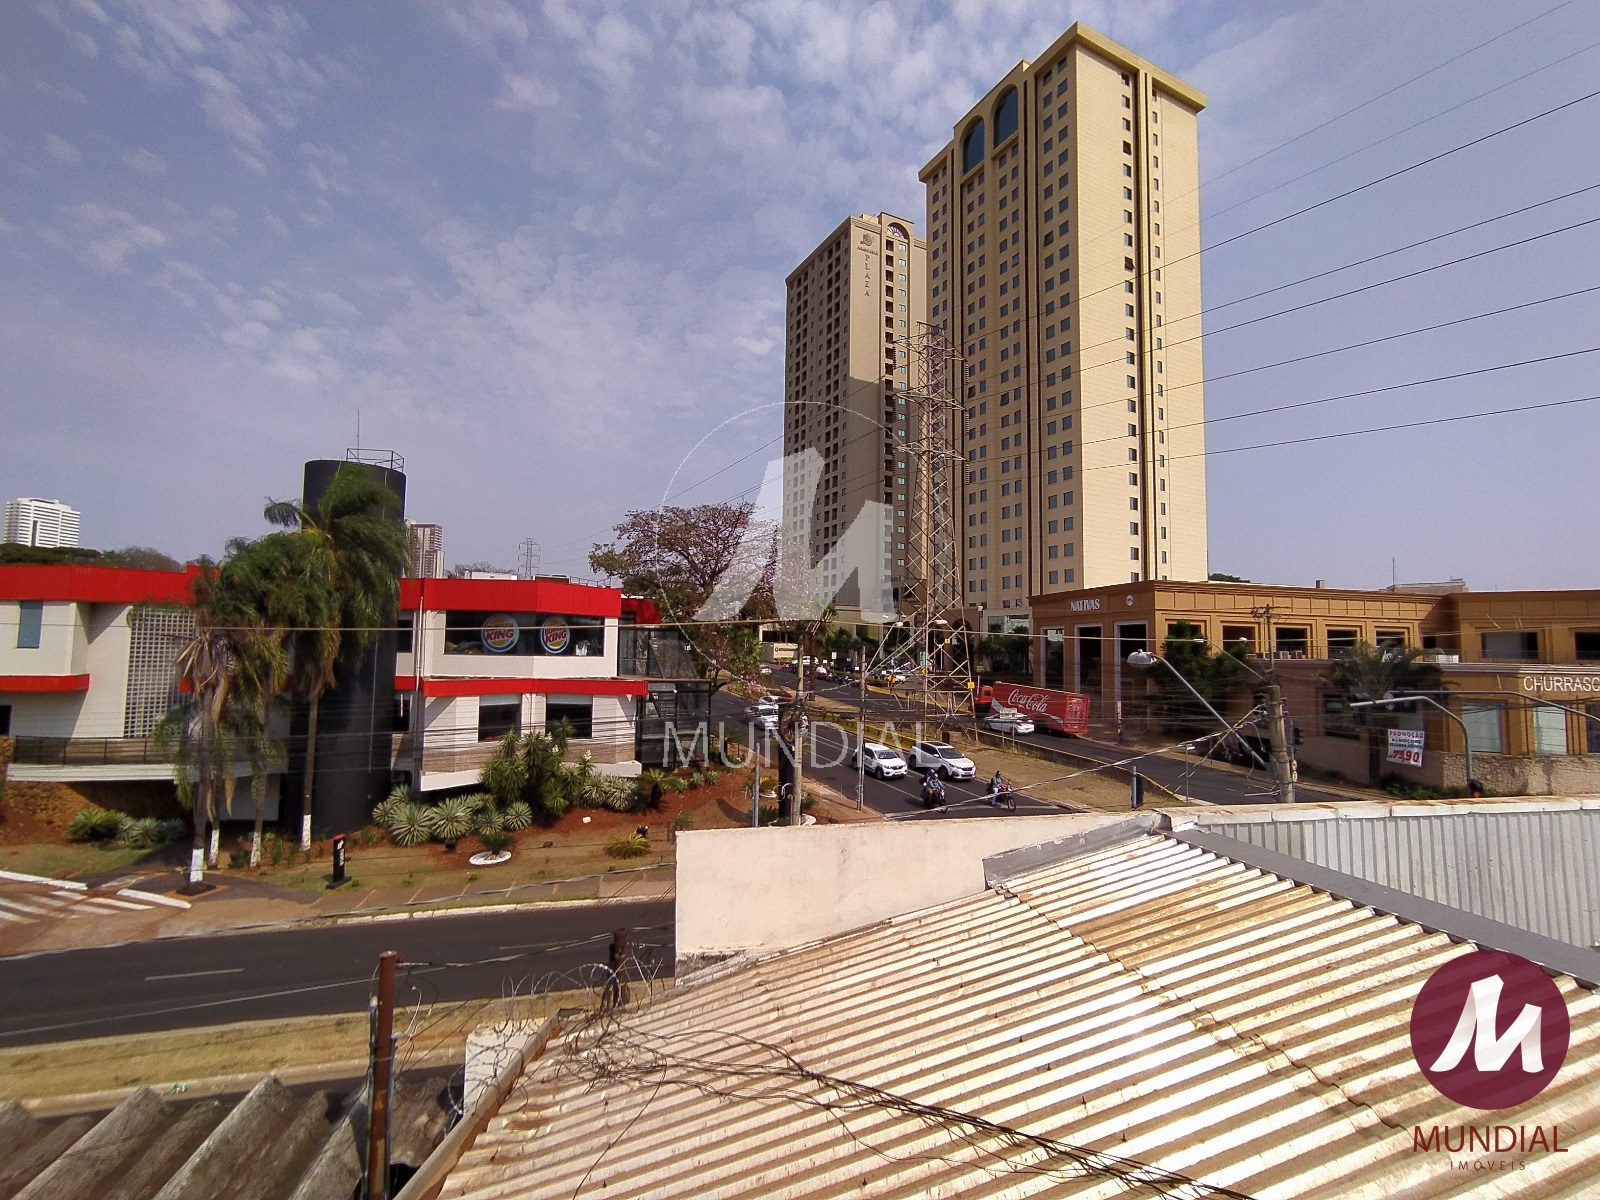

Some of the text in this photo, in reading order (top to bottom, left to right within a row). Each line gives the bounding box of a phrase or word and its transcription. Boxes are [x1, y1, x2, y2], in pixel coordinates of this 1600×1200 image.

[1070, 599, 1100, 611] NATIVAS
[486, 630, 514, 641] KING
[544, 630, 567, 643] KING
